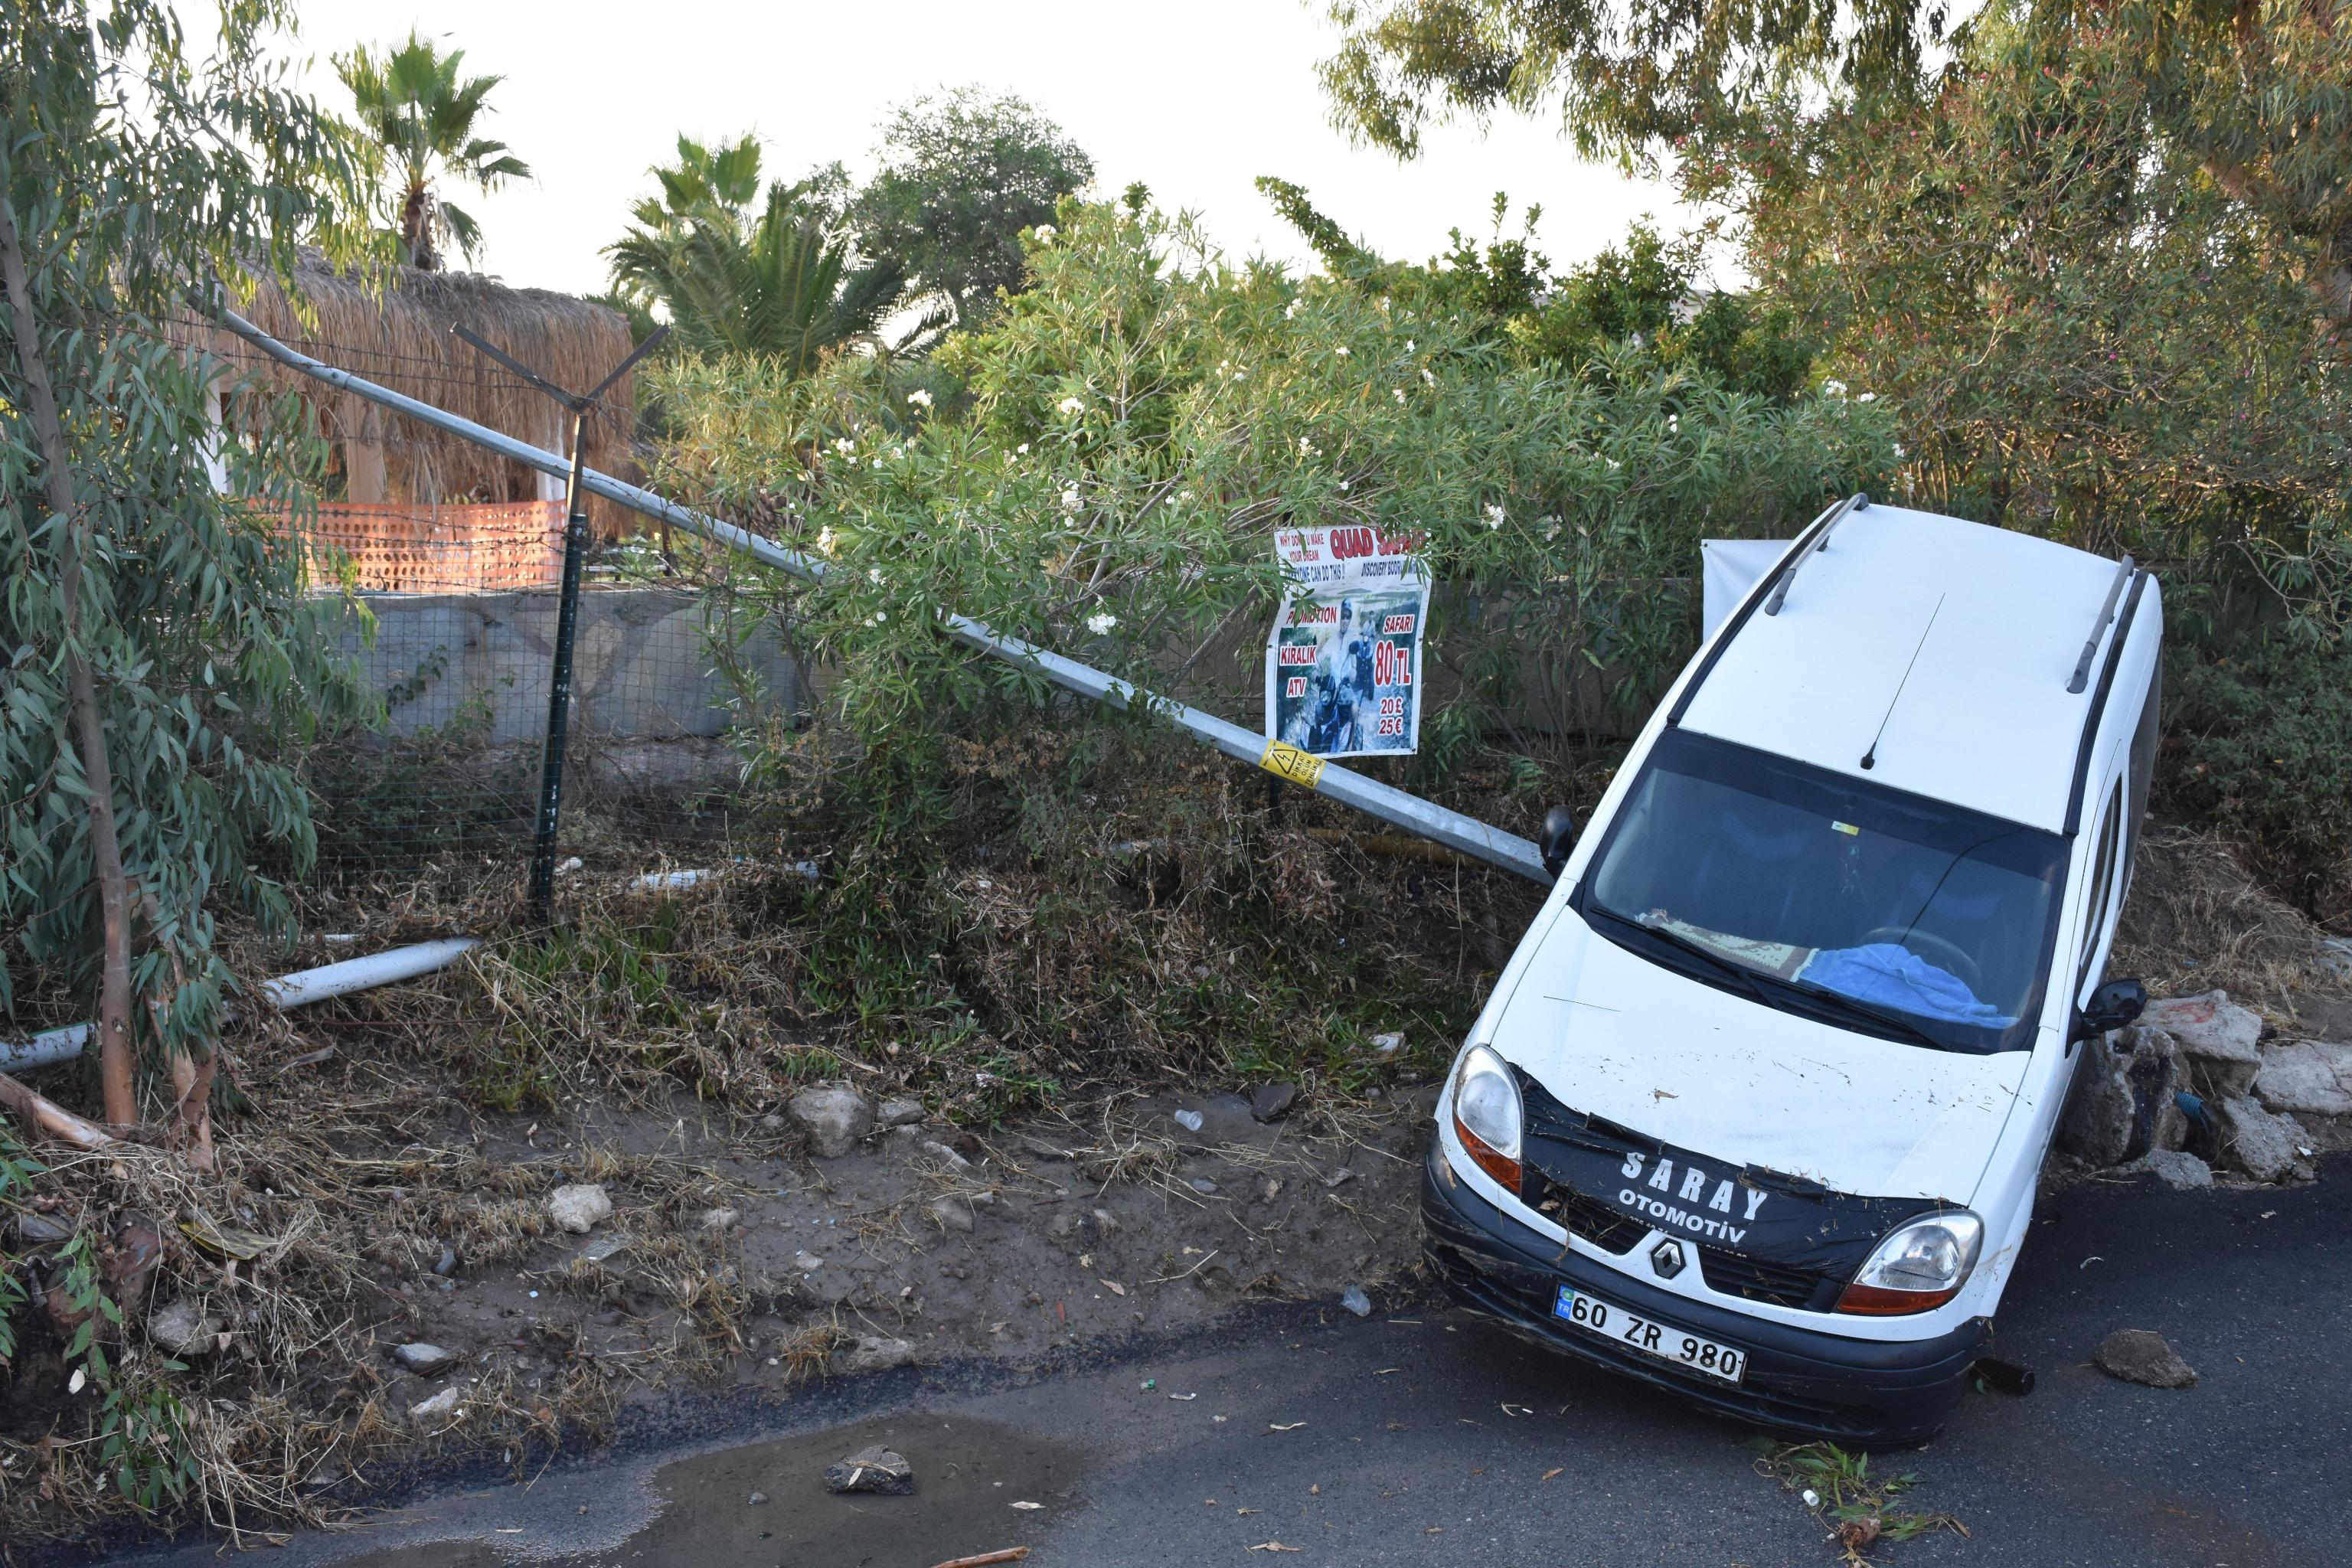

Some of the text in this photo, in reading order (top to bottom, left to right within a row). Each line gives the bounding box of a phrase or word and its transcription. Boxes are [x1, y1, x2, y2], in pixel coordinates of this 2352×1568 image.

[1279, 535, 1290, 547] WHY
[1310, 533, 1325, 545] MAKE
[1330, 528, 1374, 561] QUAD
[1289, 550, 1302, 562] YOUR
[1310, 566, 1321, 582] CAN
[1322, 566, 1329, 581] DO
[1329, 564, 1341, 581] THIS
[1361, 561, 1387, 577] DISCOVERY
[1387, 560, 1407, 575] BODRU
[1383, 616, 1413, 633] SAFARI
[1375, 641, 1410, 686] 80 TL
[1288, 678, 1305, 696] ATV
[1380, 698, 1393, 714] 20
[1379, 719, 1393, 734] 25
[1621, 1152, 1768, 1220] SARAY
[1619, 1189, 1746, 1243] OTOMOTİV
[1559, 1303, 1570, 1314] TR
[1572, 1297, 1738, 1376] 60 ZR 980
